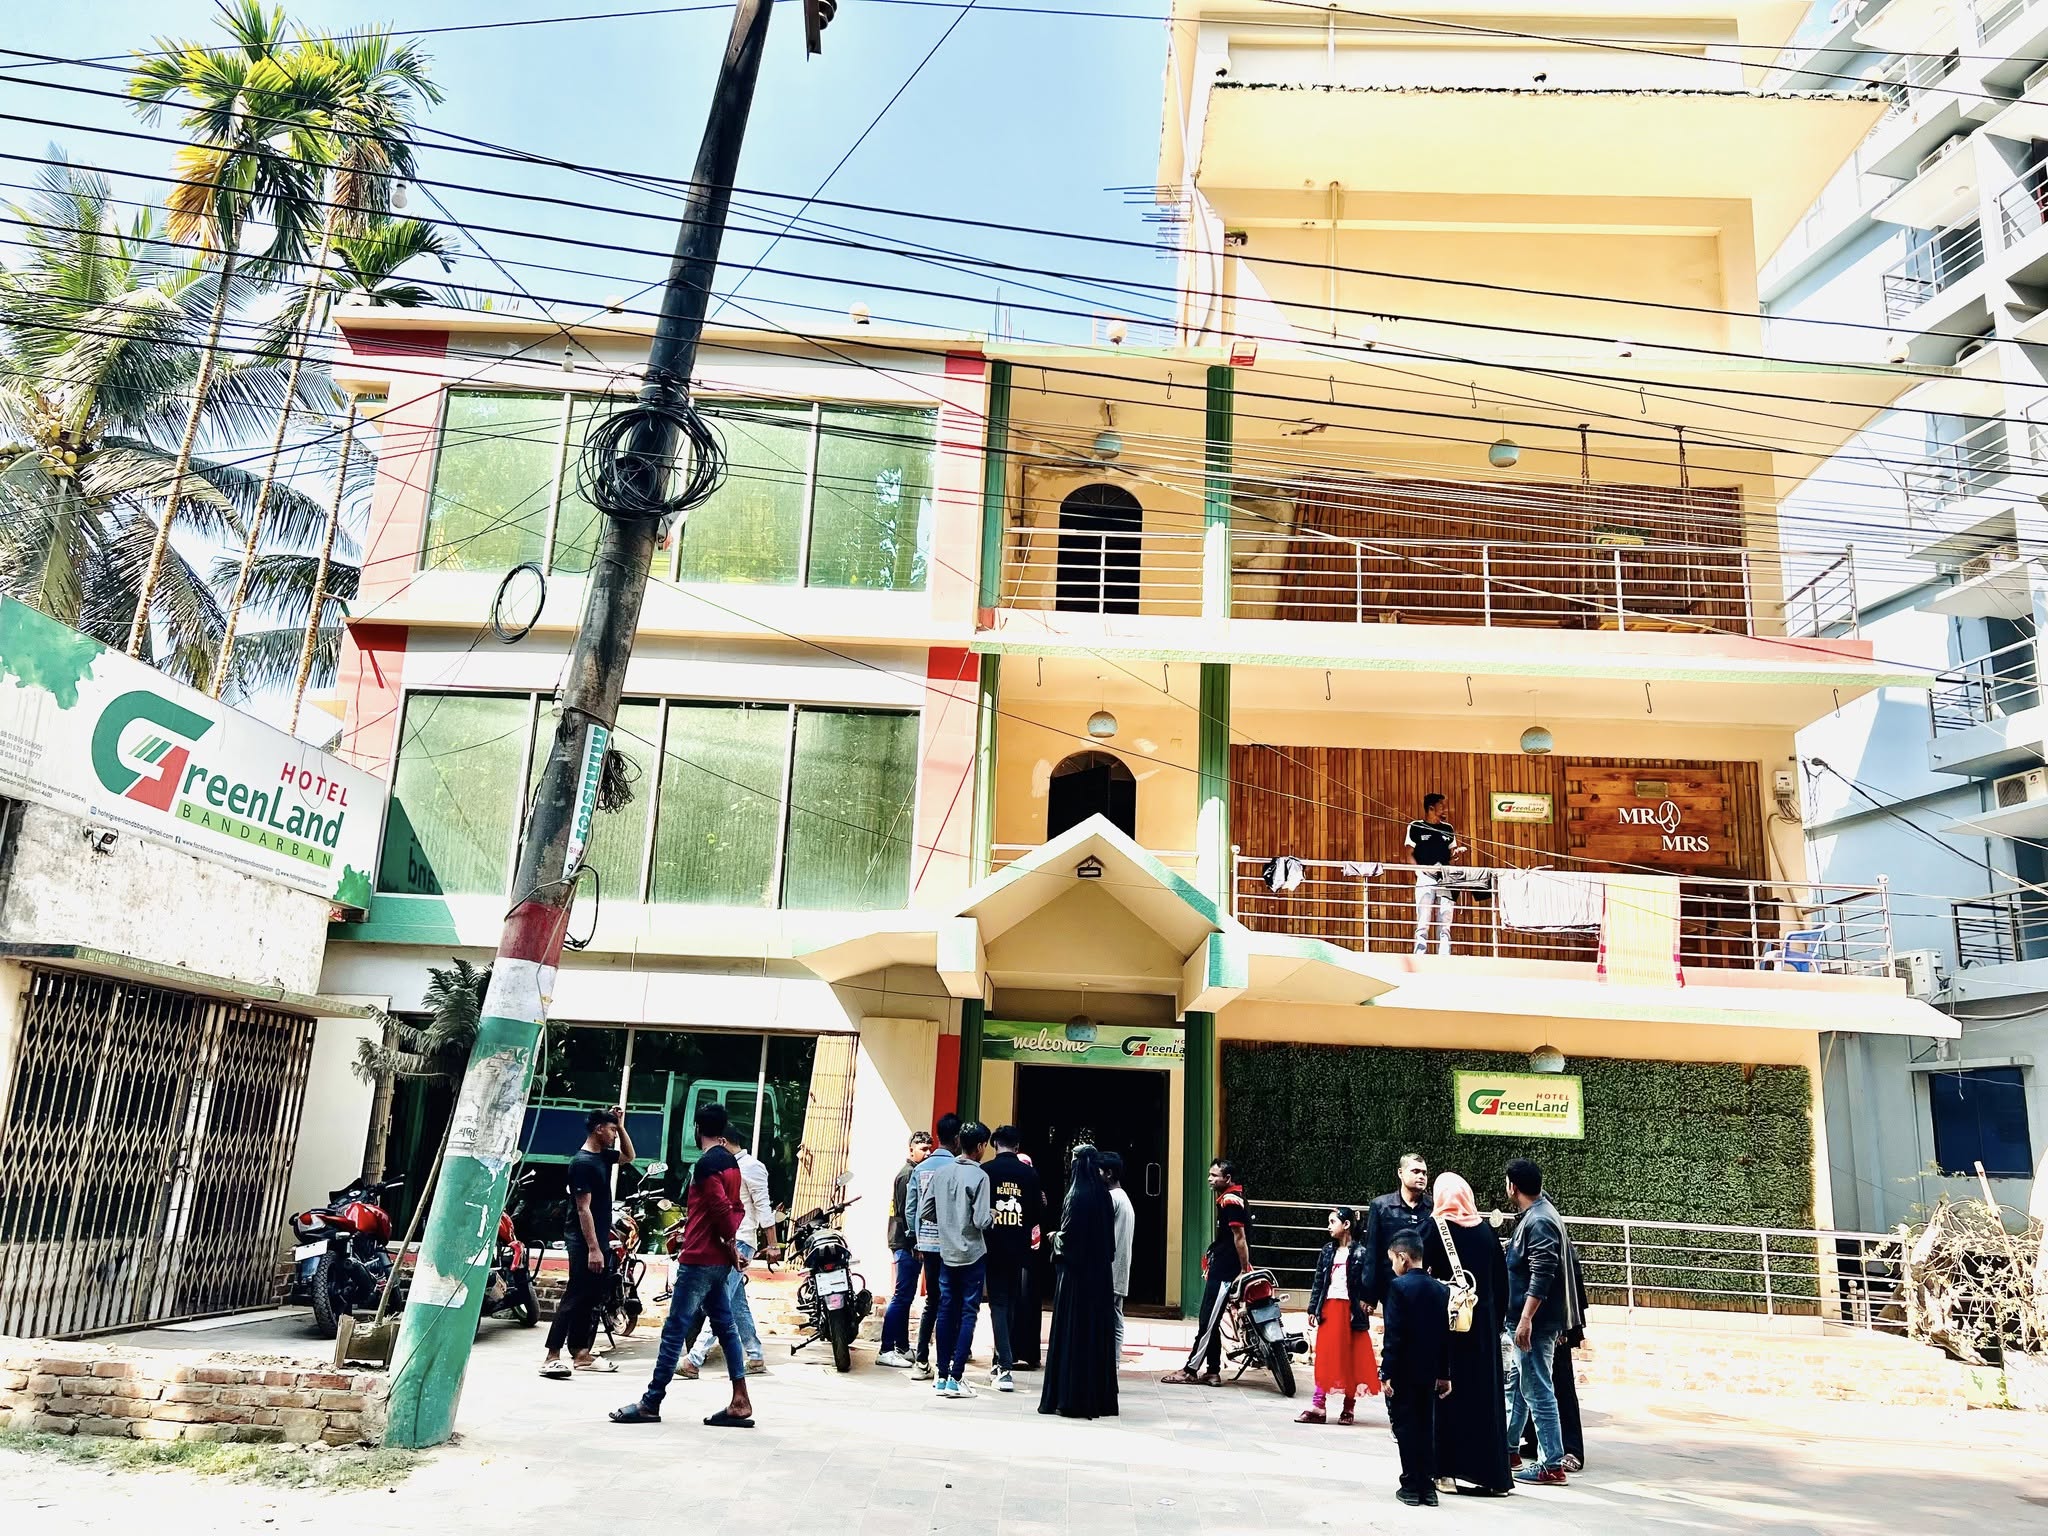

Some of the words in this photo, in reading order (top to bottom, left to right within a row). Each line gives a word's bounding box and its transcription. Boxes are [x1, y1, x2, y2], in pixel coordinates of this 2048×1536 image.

[91, 690, 345, 849] GreenLand
[281, 762, 348, 807] HOTEL
[575, 726, 607, 844] minister
[1497, 801, 1545, 813] GreenLand
[1617, 807, 1657, 825] MR
[182, 803, 332, 868] BANDARBAN
[1661, 835, 1710, 852] MRS
[1013, 1027, 1090, 1053] welcome
[1467, 1089, 1570, 1115] GreenLand
[1536, 1093, 1570, 1101] HOTEL
[993, 1211, 1023, 1227] RIDE
[1444, 1237, 1456, 1257] LOVE
